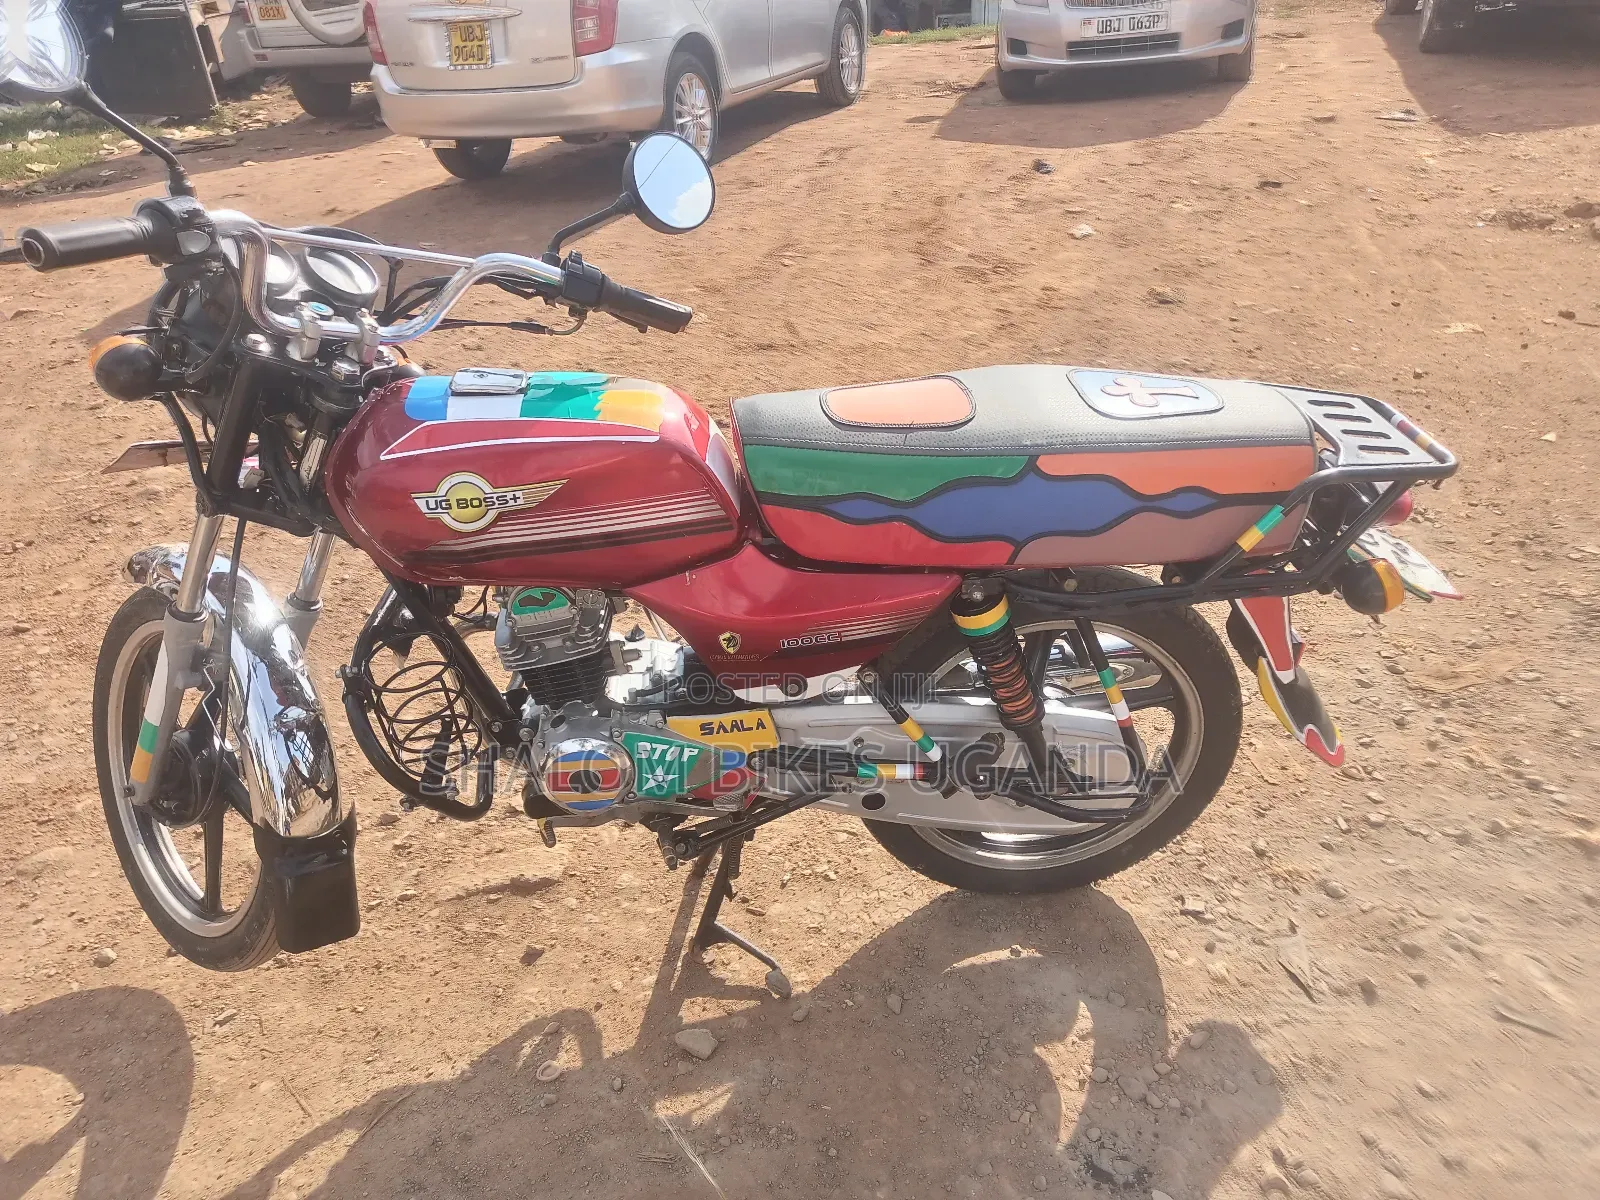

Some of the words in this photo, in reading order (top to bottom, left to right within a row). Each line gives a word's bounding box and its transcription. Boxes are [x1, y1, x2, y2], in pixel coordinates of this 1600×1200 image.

[459, 24, 484, 43] UBJ
[425, 498, 452, 511] UG
[456, 493, 521, 510] BOSS+
[780, 632, 841, 649] 100CC
[699, 717, 767, 737] SAALA
[636, 741, 700, 762] STOP
